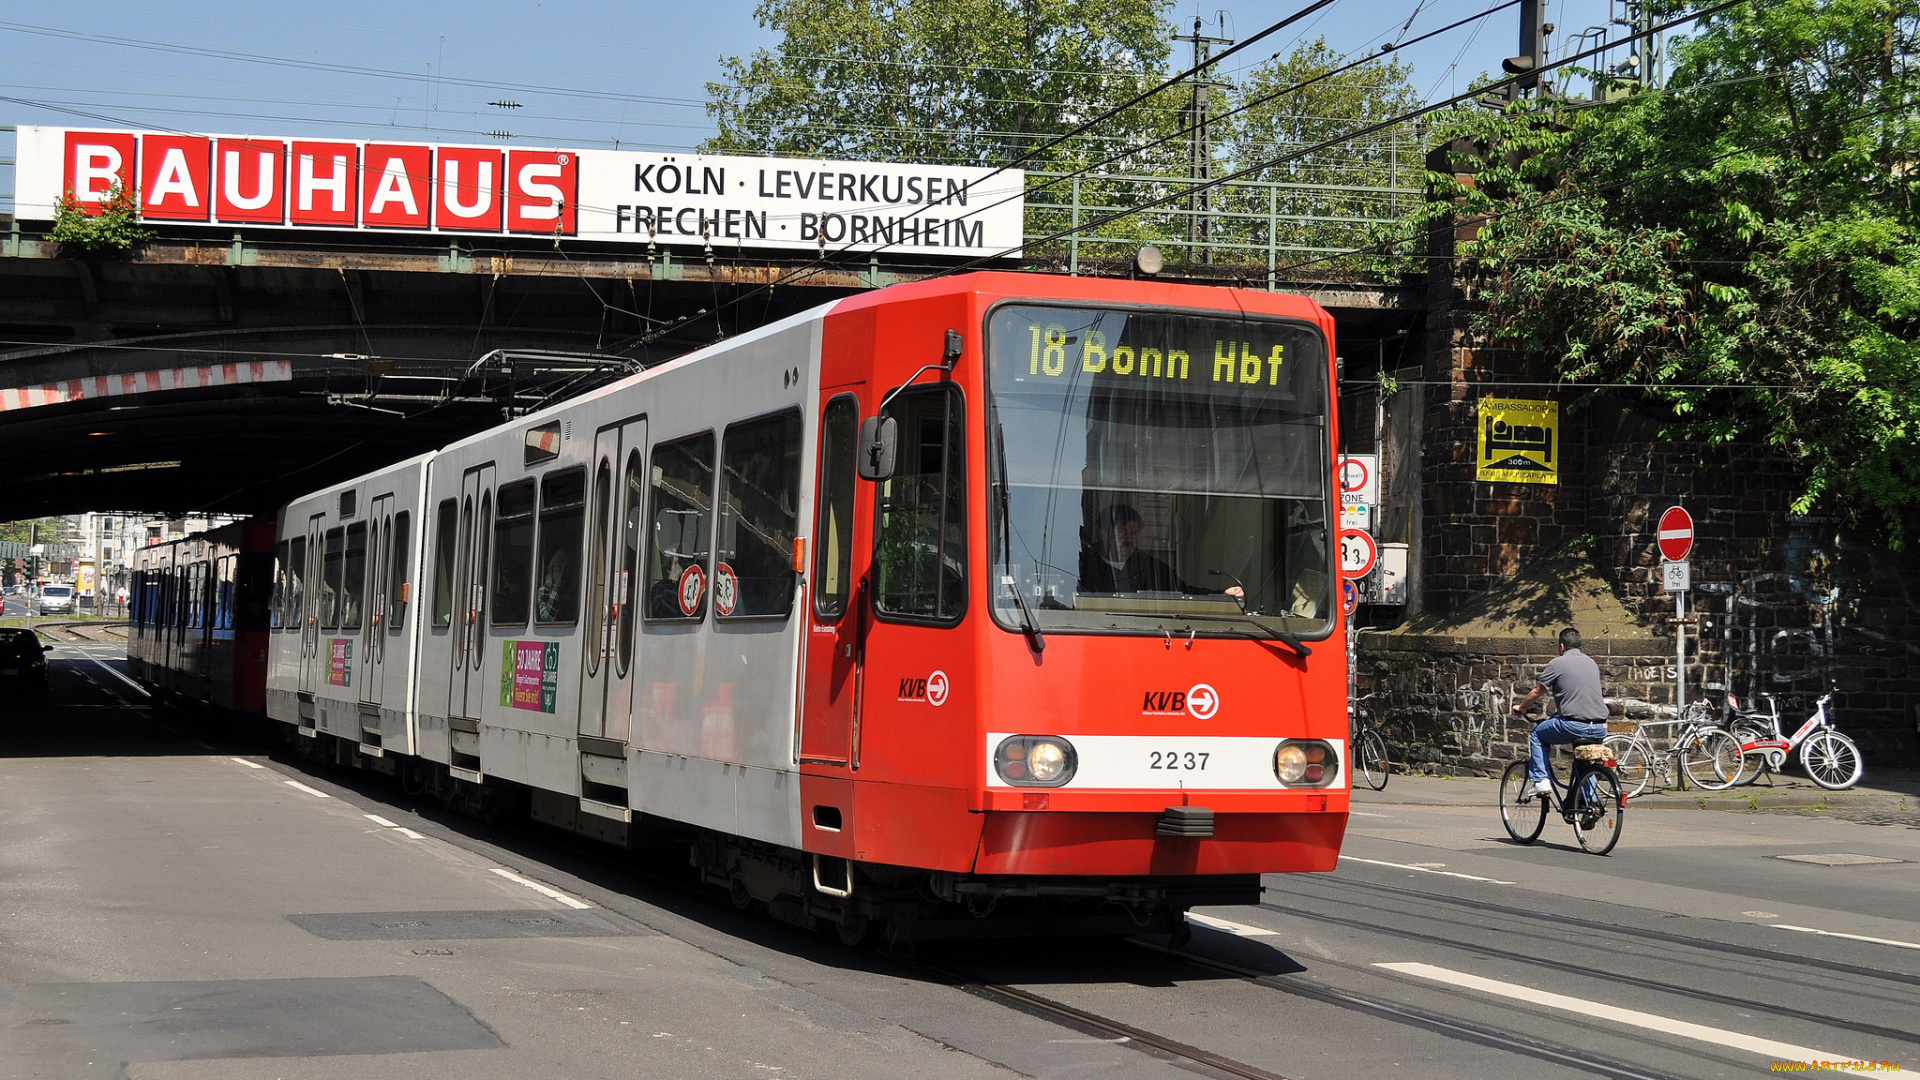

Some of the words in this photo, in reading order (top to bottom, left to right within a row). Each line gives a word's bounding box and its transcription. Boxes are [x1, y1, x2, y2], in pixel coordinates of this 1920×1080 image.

[634, 157, 725, 196] KÖLN
[759, 169, 969, 208] LEVERKUSEN
[616, 204, 767, 239] FRECHEN
[801, 213, 985, 249] BORNHEIM
[1028, 322, 1067, 377] 18
[1082, 330, 1190, 380] Bonn
[1212, 339, 1284, 386] Hbf
[898, 678, 927, 698] KVB
[1143, 692, 1186, 711] KVB
[1150, 751, 1210, 771] 2237
